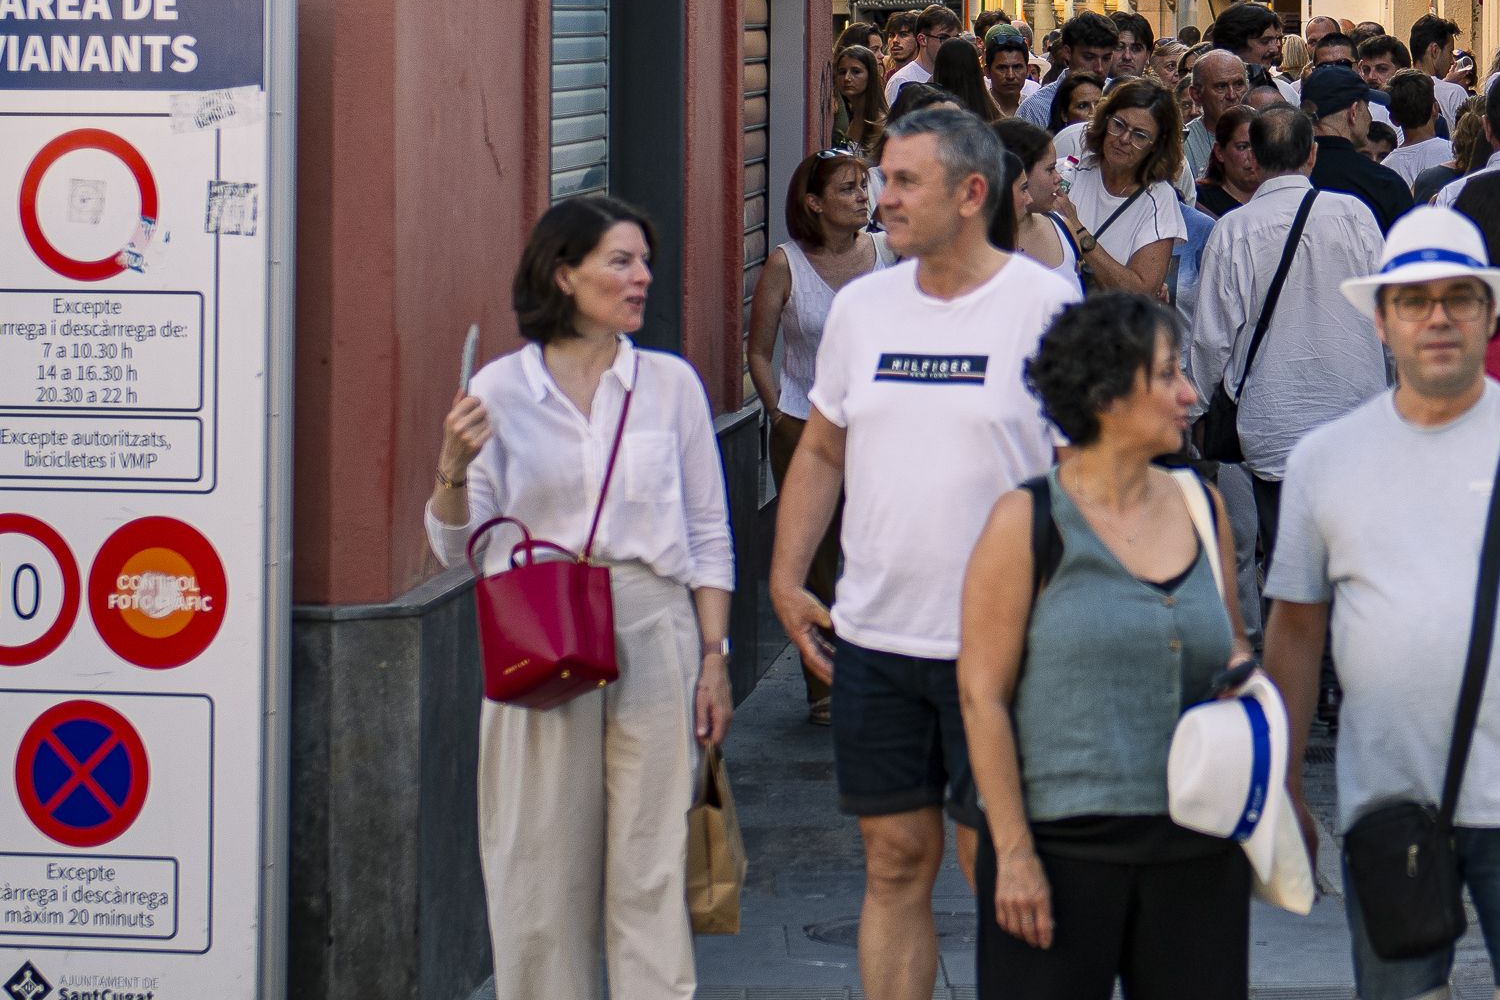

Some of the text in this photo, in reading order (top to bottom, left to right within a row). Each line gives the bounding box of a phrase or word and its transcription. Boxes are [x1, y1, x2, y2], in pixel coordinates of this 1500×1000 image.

[0, 35, 199, 73] IANANTS
[53, 298, 122, 318] Excepte
[0, 320, 188, 342] rrega i descàrrega de:
[42, 343, 133, 359] 7 a 10.30 h
[36, 365, 138, 382] 14 a 16.30 h
[891, 358, 971, 374] HILFIGER
[35, 387, 138, 404] 20.30 a 22 h
[0, 428, 171, 451] Excepte autoritzats,
[24, 450, 158, 469] bicicletes i VMP
[116, 574, 201, 593] COOL
[47, 863, 116, 884] Excepte
[62, 886, 68, 902] i
[71, 886, 169, 911] descàrrega
[5, 906, 155, 928] màxim 20 minuts
[58, 975, 159, 990] AJUNTAMENT DE
